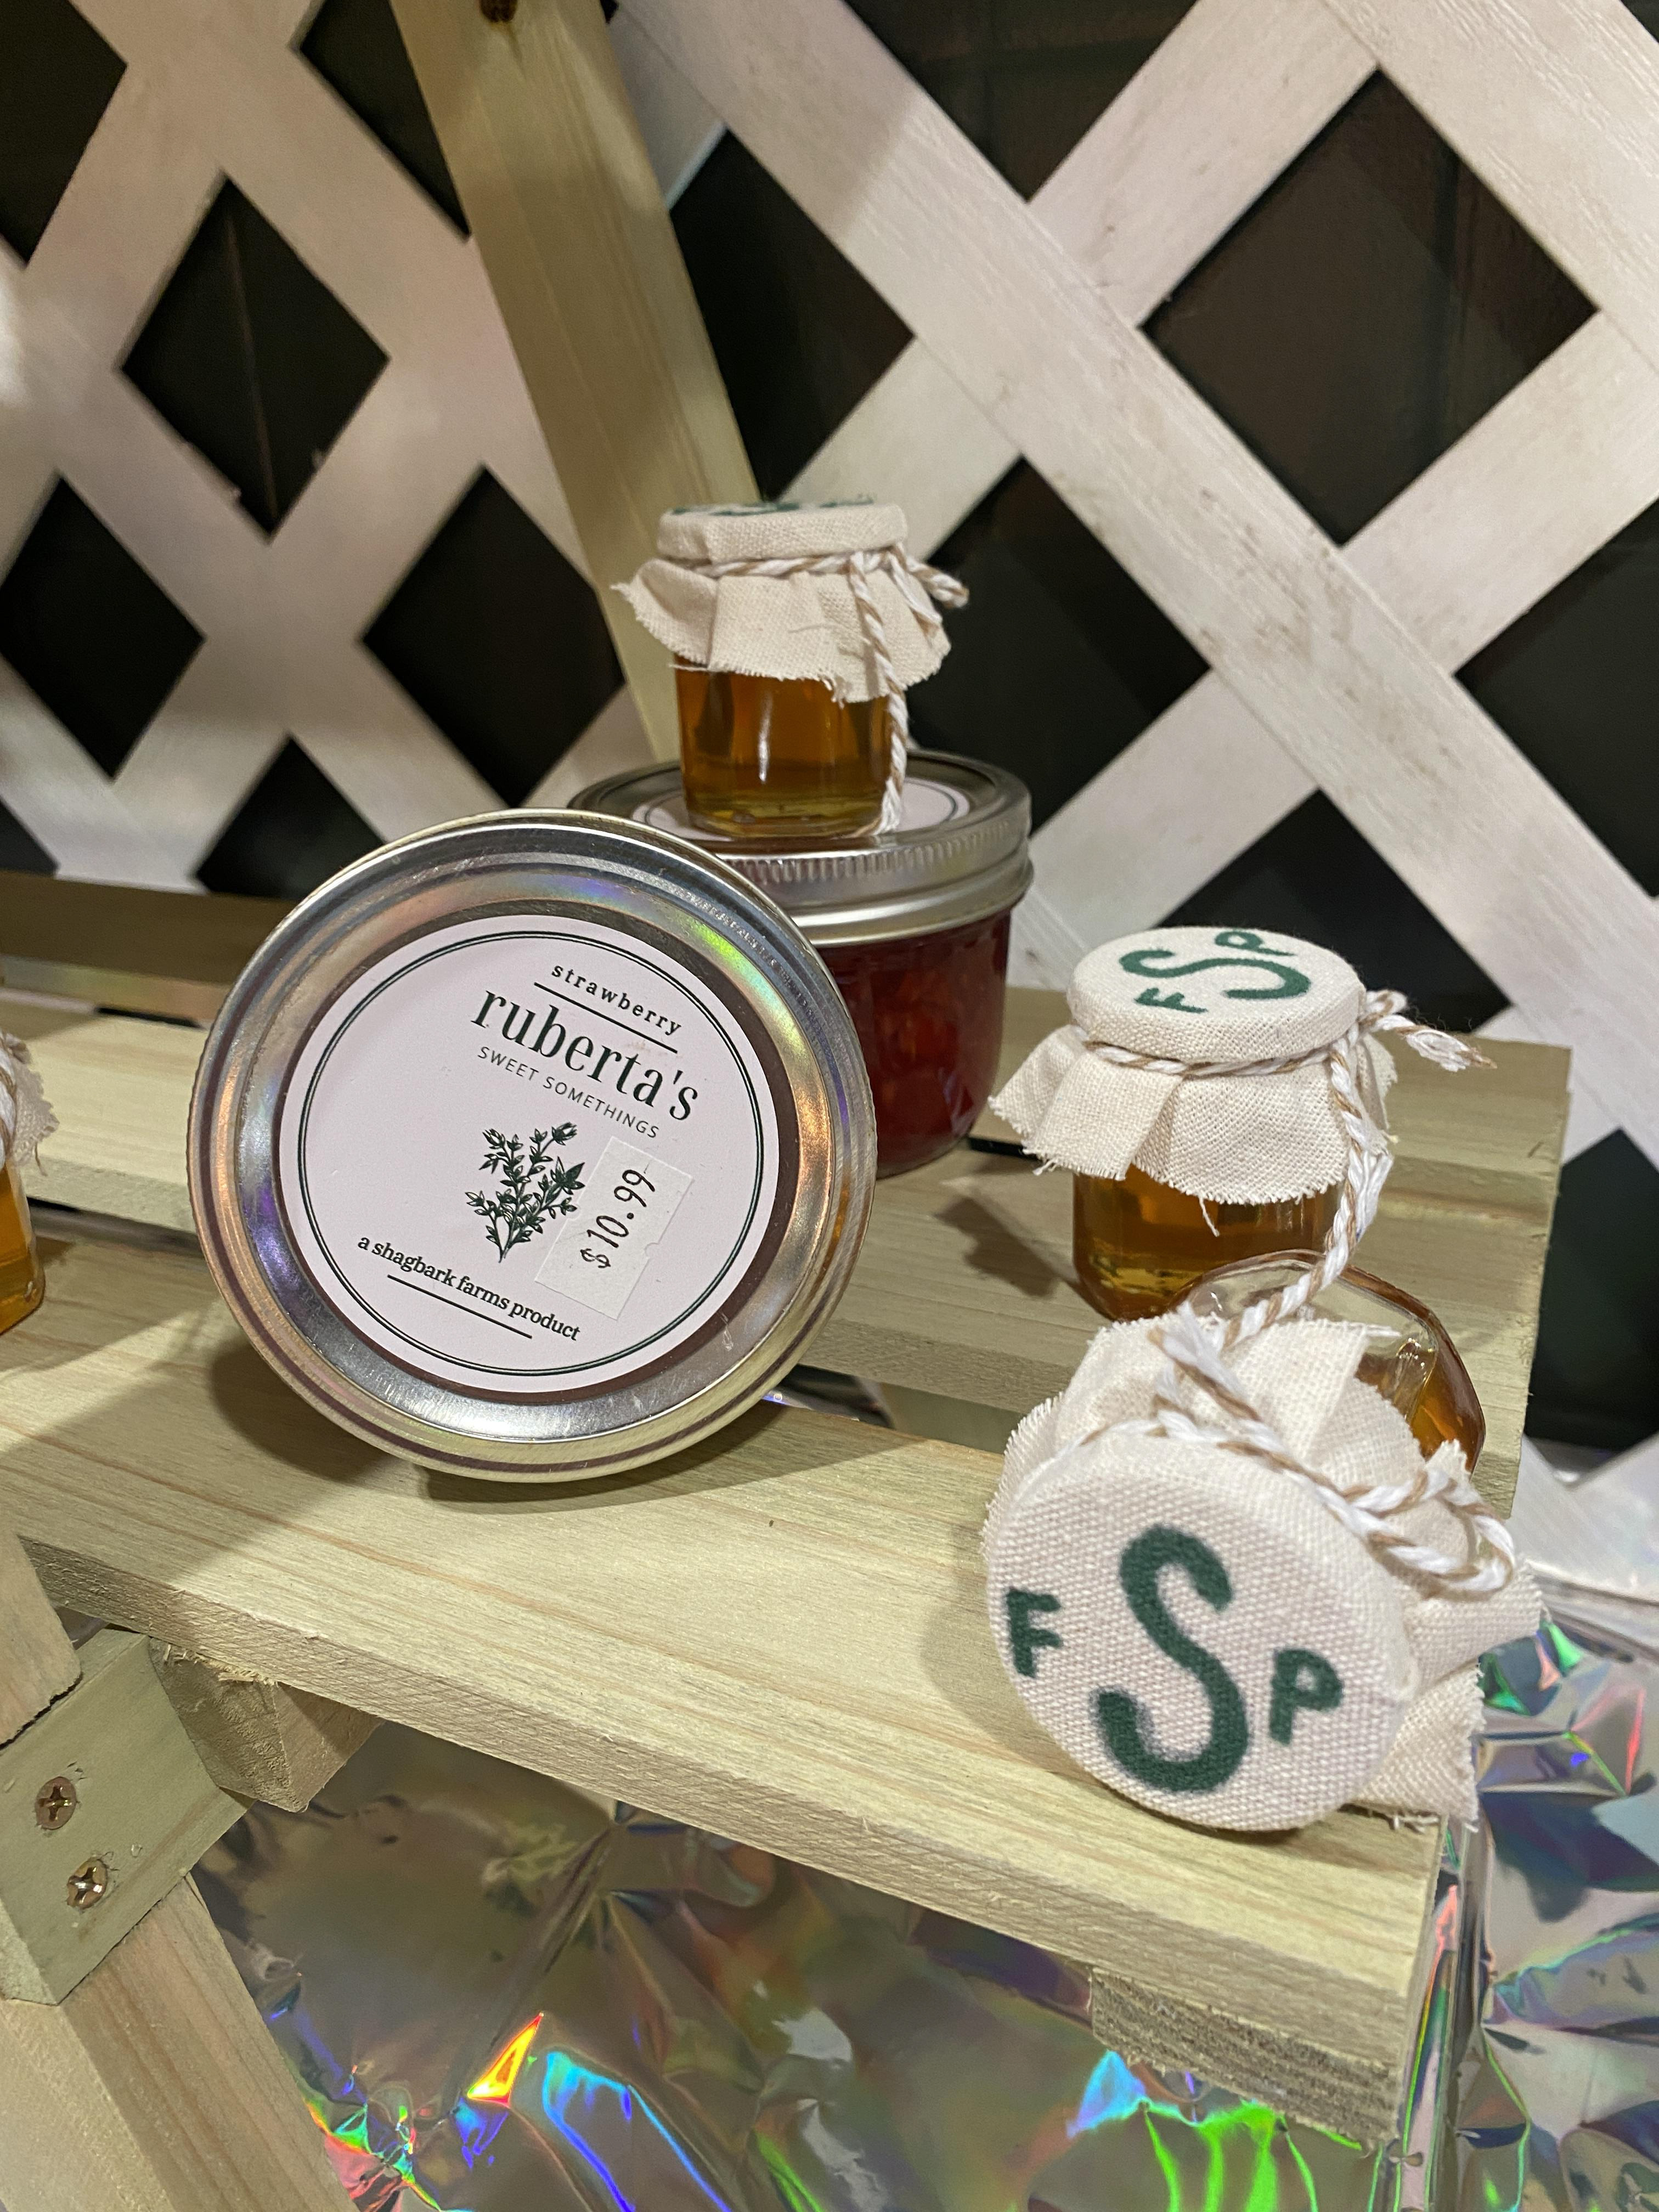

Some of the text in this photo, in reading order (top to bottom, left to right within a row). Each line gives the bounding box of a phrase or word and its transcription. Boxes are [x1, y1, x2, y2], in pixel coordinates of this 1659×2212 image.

[551, 966, 682, 1036] strawberry
[470, 990, 698, 1121] ruberta's
[477, 1046, 659, 1138] SWEET SOMETHINGS
[580, 1169, 656, 1268] $10.99
[357, 1235, 580, 1341] a shagbark farms product
